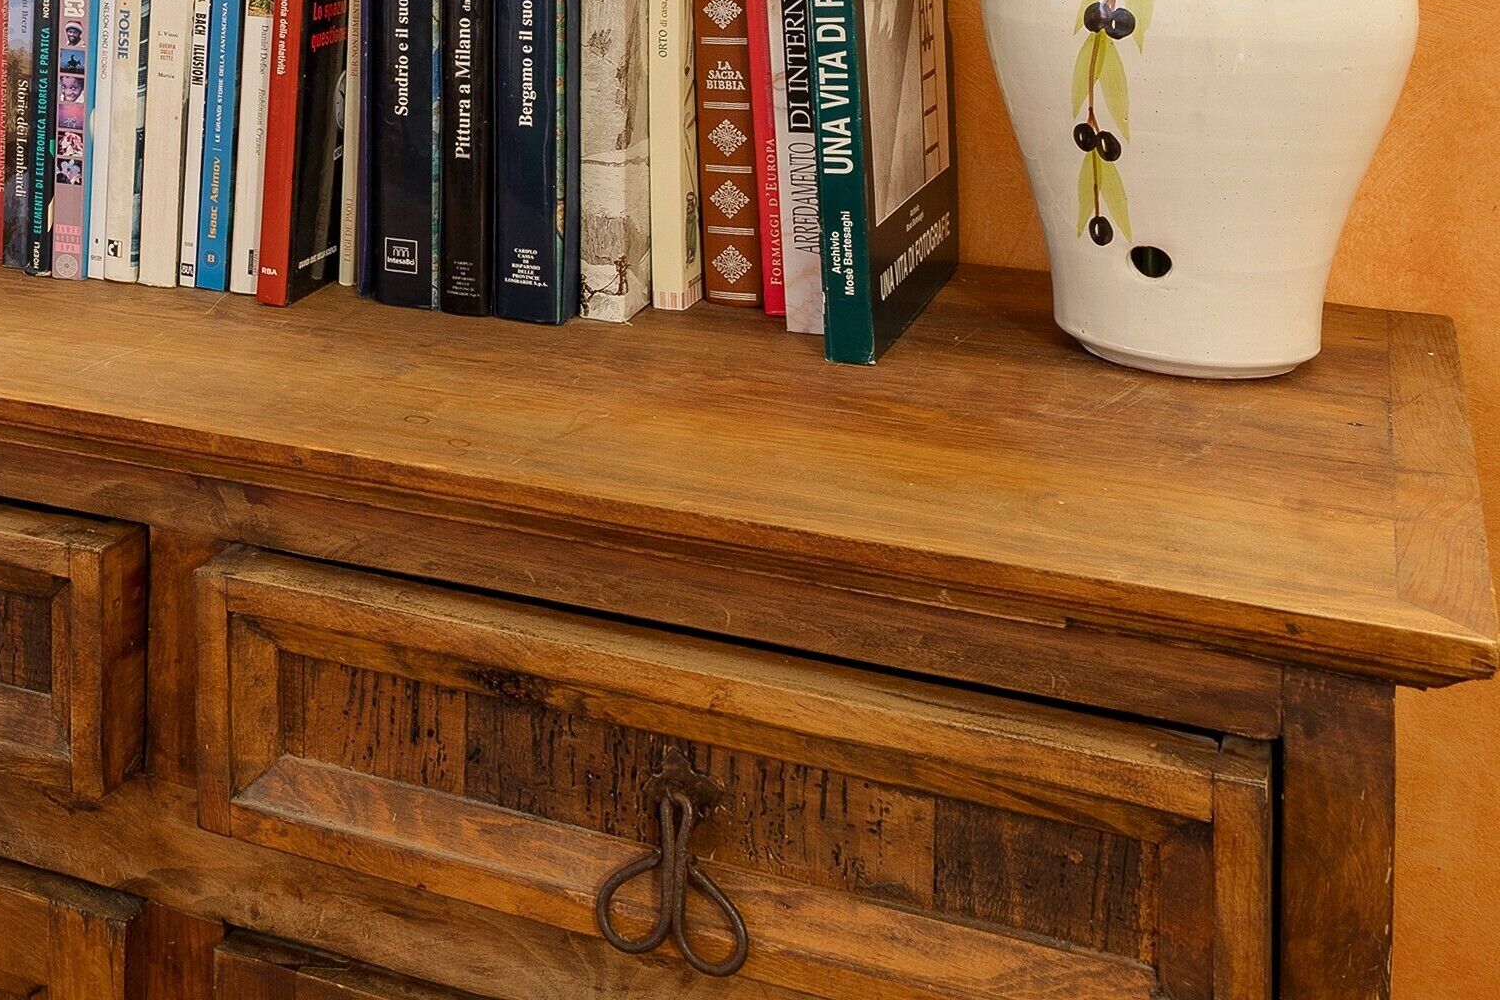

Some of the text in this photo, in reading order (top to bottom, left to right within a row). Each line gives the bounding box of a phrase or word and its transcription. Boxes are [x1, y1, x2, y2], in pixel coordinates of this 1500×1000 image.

[21, 10, 29, 34] Brera
[194, 13, 206, 35] BACH
[279, 18, 288, 38] della
[398, 0, 409, 19] suo
[523, 0, 533, 26] suo
[39, 27, 50, 66] PRATICA
[118, 9, 130, 60] POESIE
[394, 28, 409, 38] il
[399, 42, 409, 50] e
[518, 30, 533, 41] il
[816, 14, 845, 44] DI
[191, 44, 205, 87] ILLUSIONI
[276, 40, 288, 75] relatività
[457, 17, 471, 83] Milano
[523, 44, 533, 53] e
[717, 60, 732, 70] LA
[393, 55, 409, 116] Sondrio
[518, 57, 536, 127] Bergamo
[706, 80, 746, 91] BIBBIA
[707, 70, 743, 80] SACRA
[818, 49, 850, 121] VITA
[37, 79, 48, 114] TEORICA
[790, 99, 811, 130] DI
[15, 80, 29, 198] Storie dei Lombardi
[255, 89, 266, 156] Robinson Crusoe
[454, 99, 471, 159] Pittura
[35, 119, 46, 176] ELETTRONICA
[823, 124, 854, 175] UNA
[35, 179, 43, 189] DI
[207, 157, 220, 239] Isaac Asimov
[787, 142, 821, 254] ARREDAMENTO
[33, 192, 43, 234] ELEMENTI
[766, 138, 781, 286] FORMAGGI D'EUROPA
[33, 241, 41, 269] HOEPLI
[830, 231, 842, 274] Archivio
[840, 210, 855, 295] Mosè Bartesaghi
[880, 265, 894, 300] UNA
[894, 252, 908, 286] VITA
[908, 244, 915, 273] DI
[915, 211, 950, 265] FOTOGRAFIE
[262, 267, 277, 276] RBA
